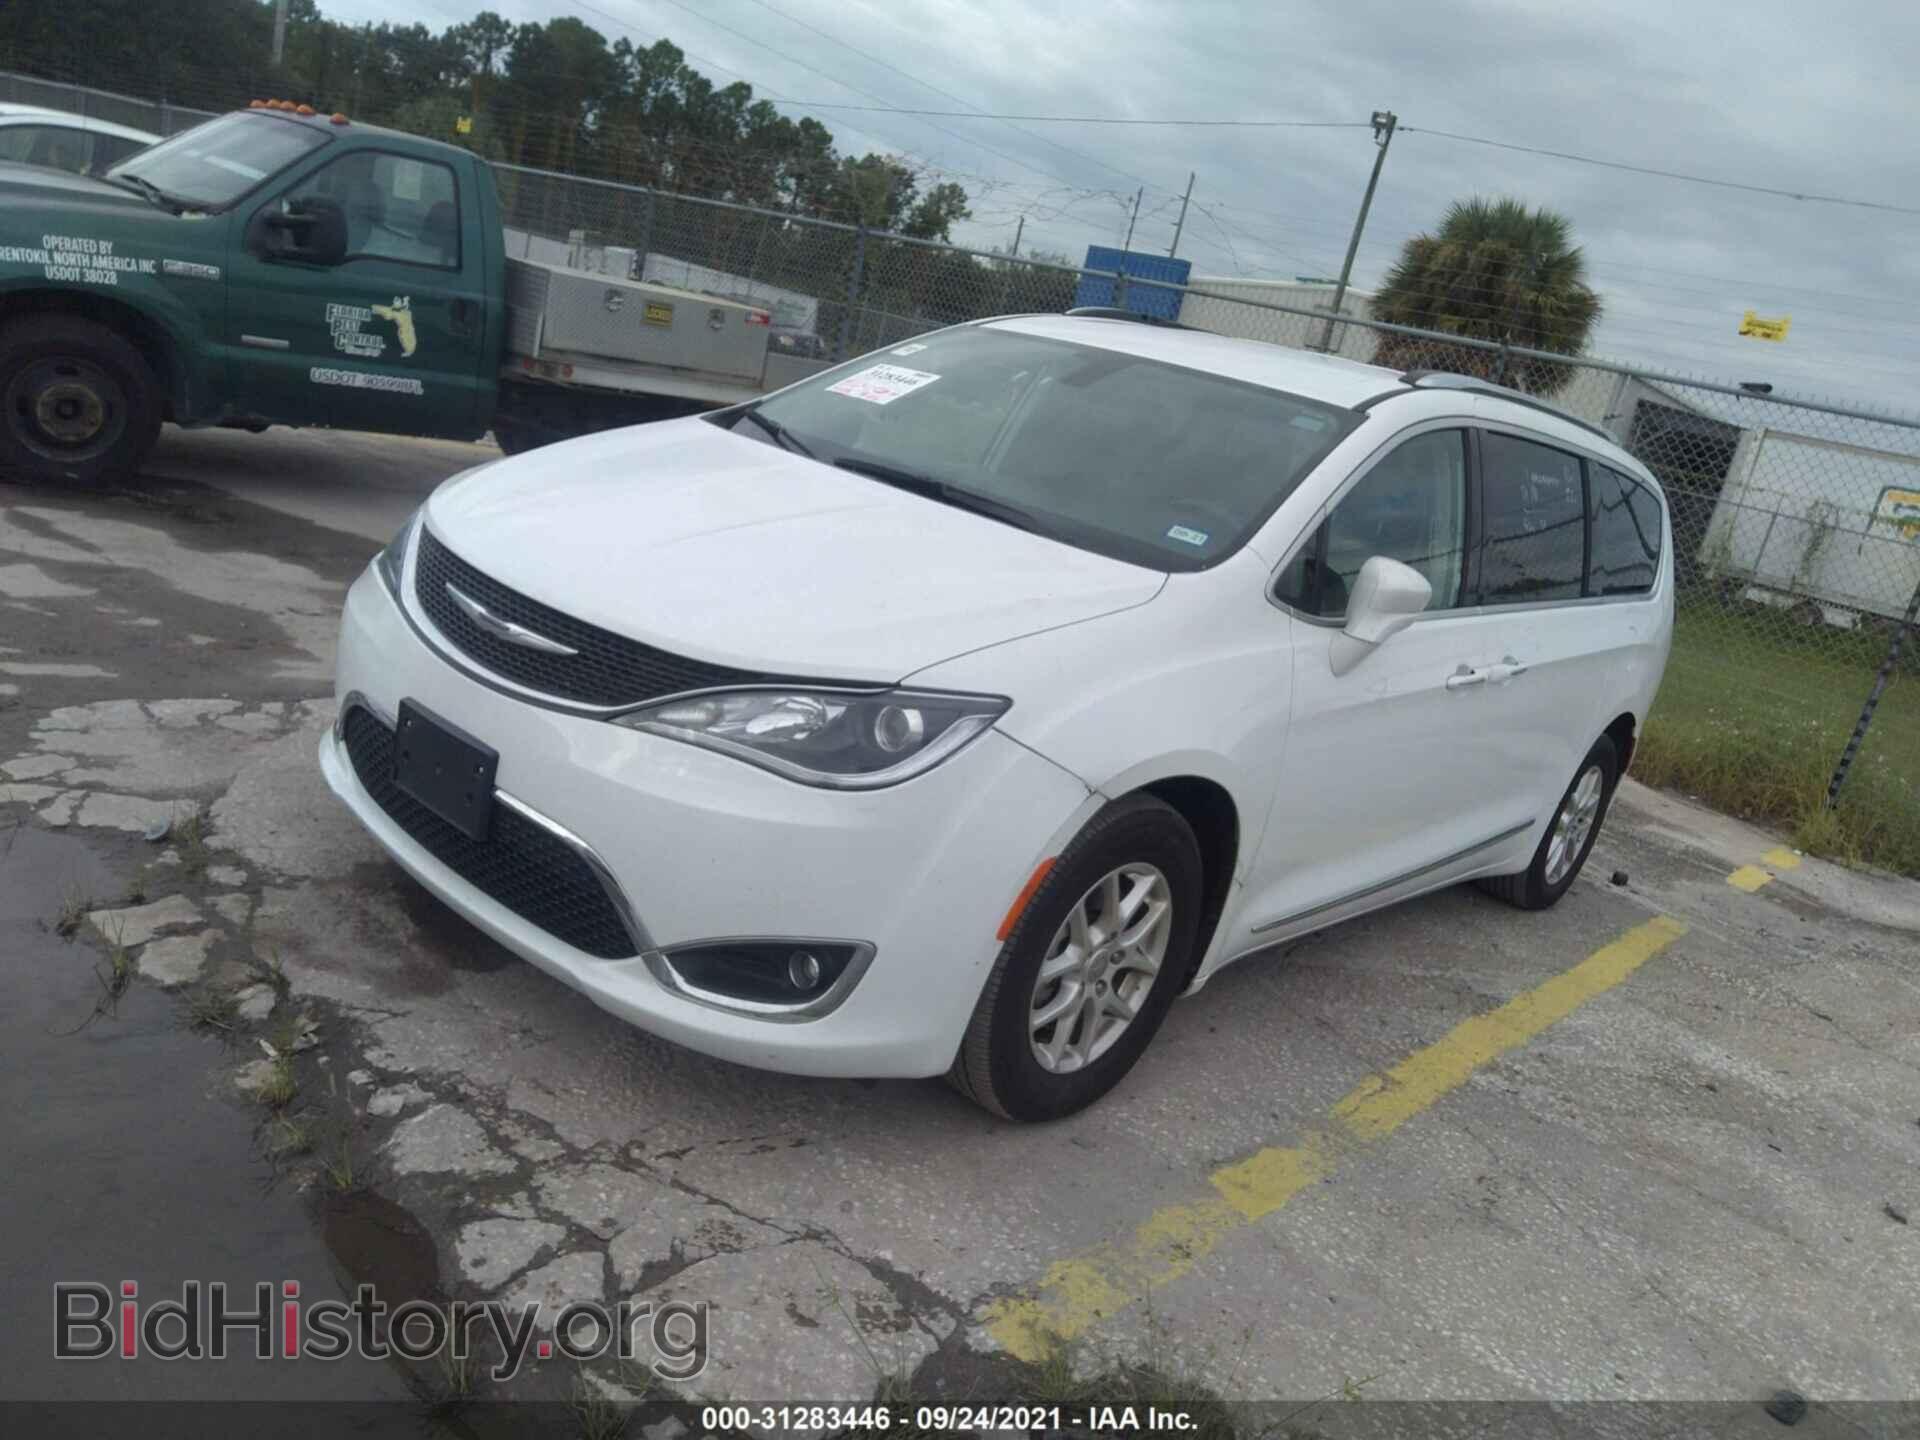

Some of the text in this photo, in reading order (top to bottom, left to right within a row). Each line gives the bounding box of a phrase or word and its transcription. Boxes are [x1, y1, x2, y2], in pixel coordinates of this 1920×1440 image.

[42, 234, 113, 255] OPERATED BY
[0, 246, 51, 264] RENTOKIL
[53, 251, 90, 268] NORTH
[92, 254, 138, 273] AMERICA
[139, 258, 157, 274] INC
[44, 265, 118, 285] USDOT 38028
[311, 367, 356, 386] USDOT
